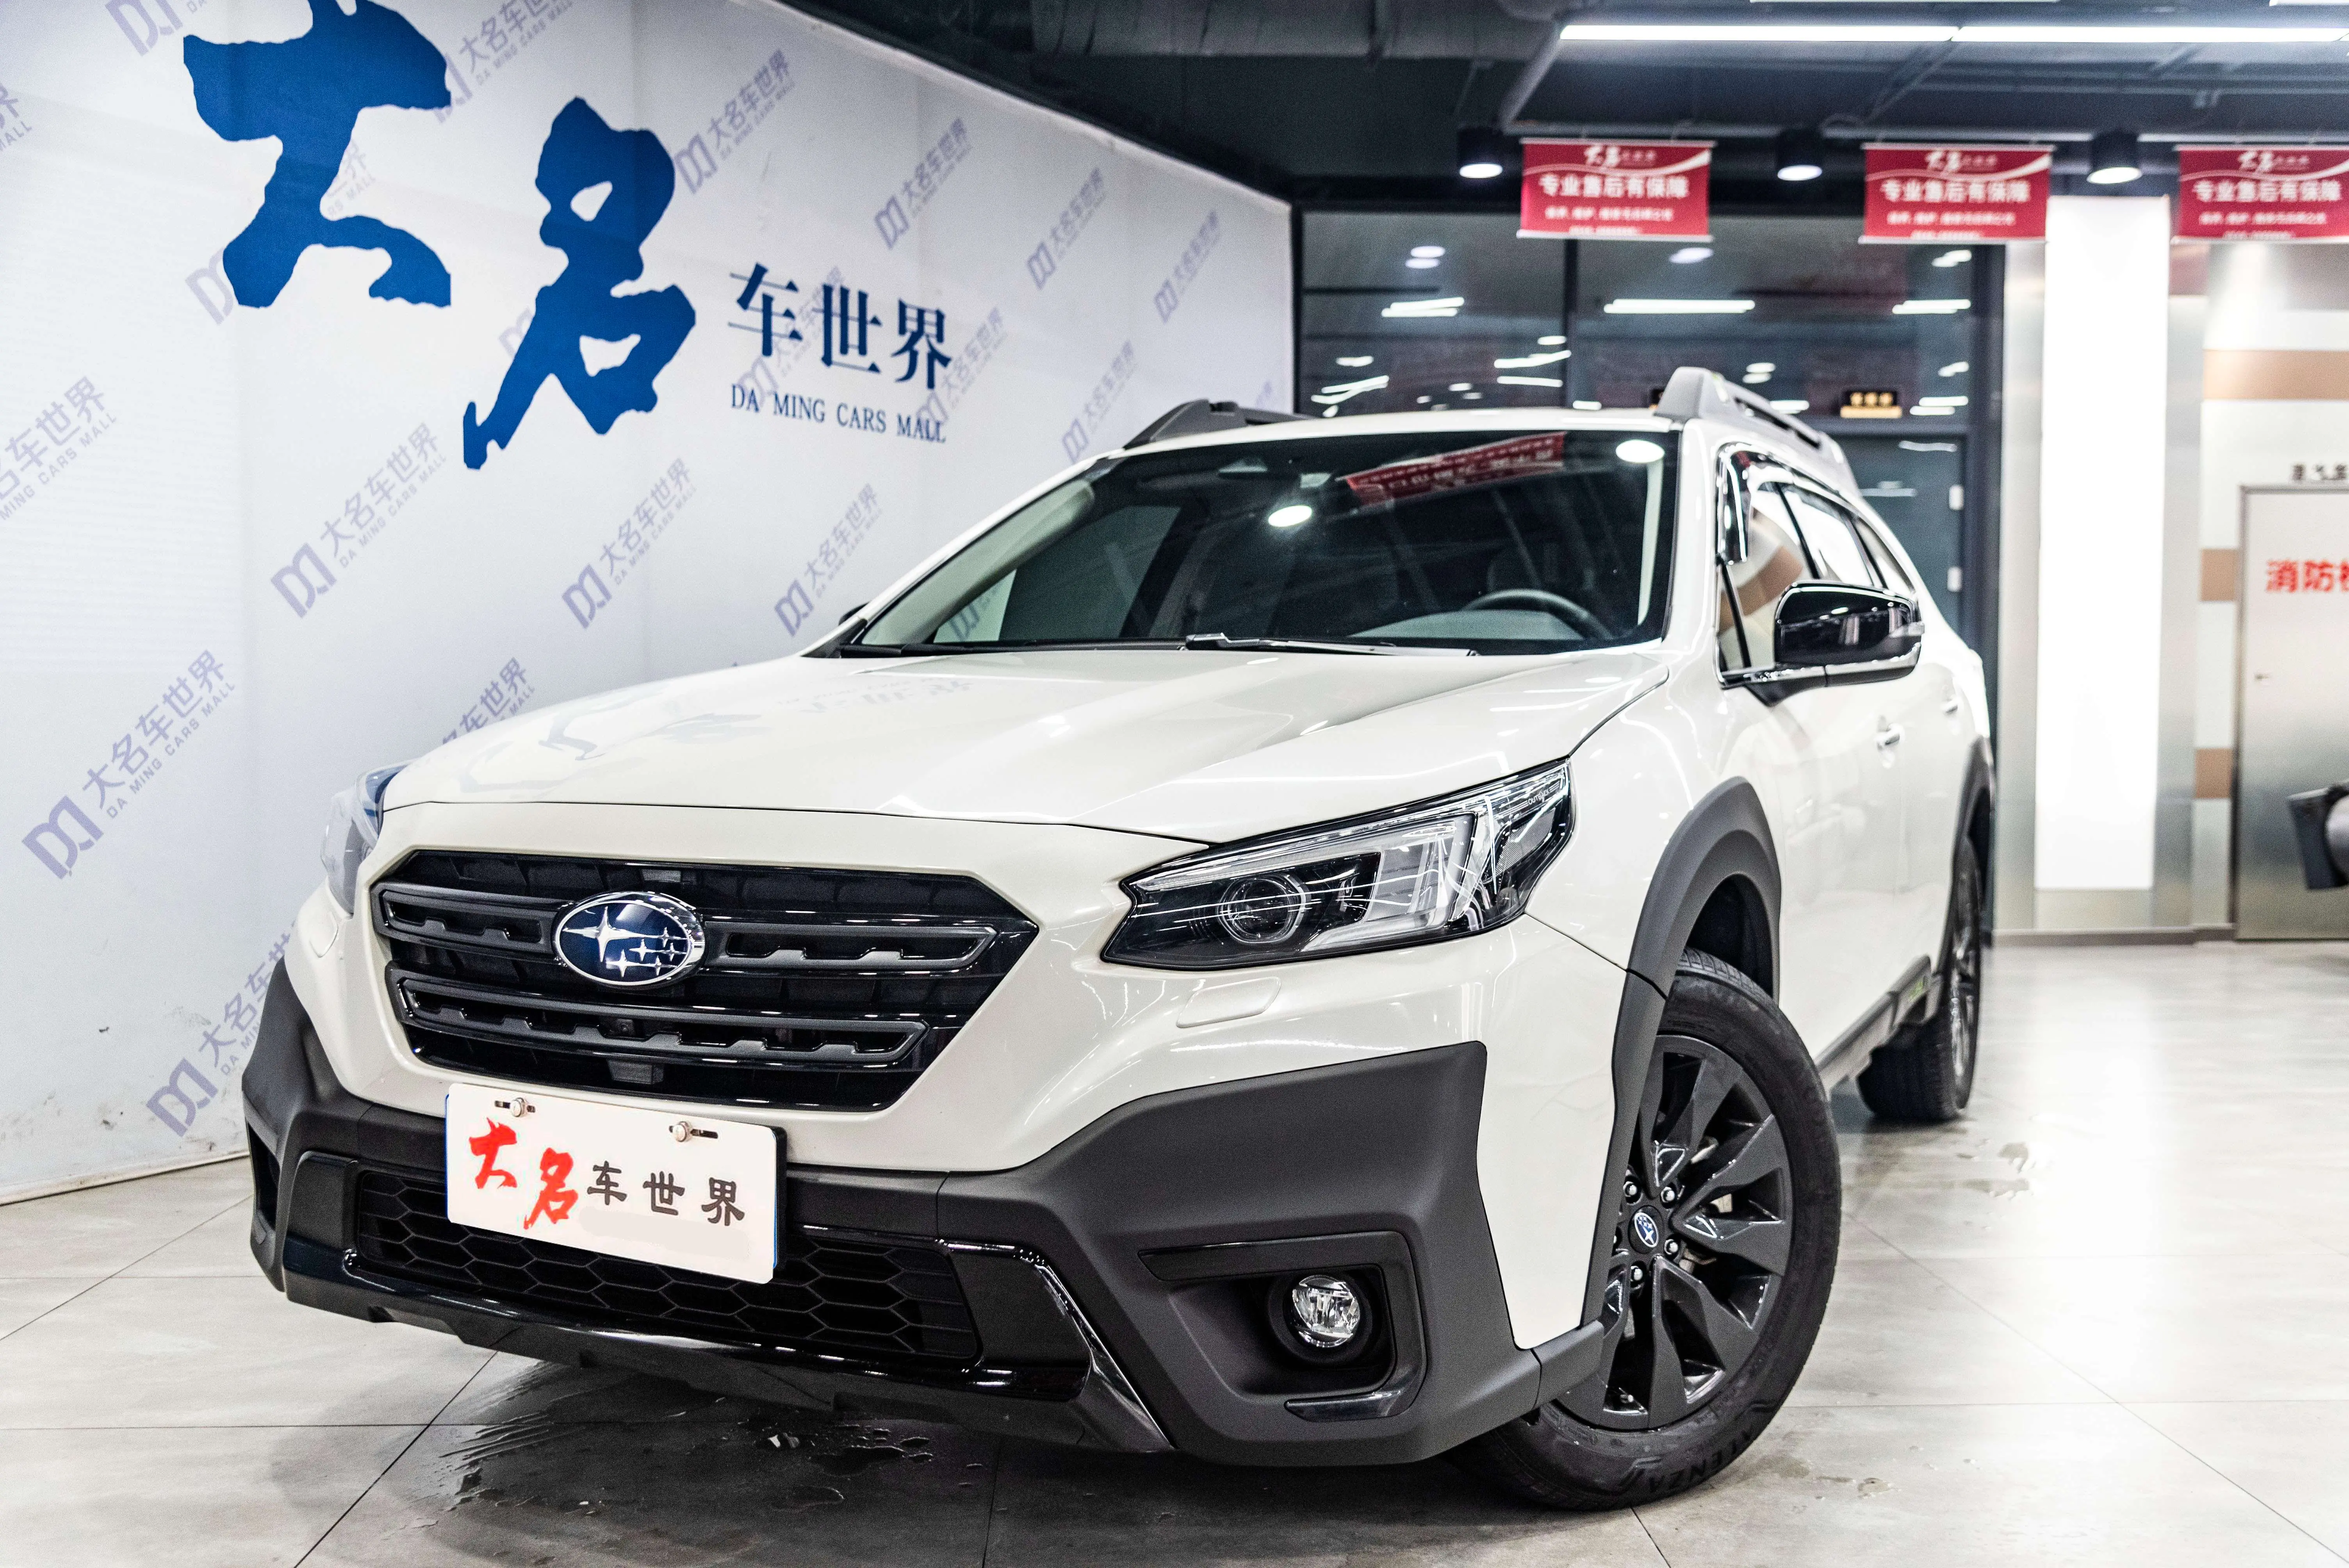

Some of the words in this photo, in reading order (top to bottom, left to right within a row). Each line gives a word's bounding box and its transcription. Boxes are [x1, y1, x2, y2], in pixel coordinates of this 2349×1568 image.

[728, 262, 952, 390] 车世界
[0, 485, 35, 520] MING
[38, 447, 77, 485] CARS
[80, 413, 117, 447] MALL
[732, 384, 759, 412] DA
[773, 390, 825, 423] MING
[837, 402, 886, 433] CARS
[897, 413, 946, 443] MALL
[320, 422, 438, 558] 大名车世界
[340, 549, 357, 568] DA
[358, 516, 386, 547] MING
[388, 484, 417, 517] CARS
[419, 454, 447, 483] MALL
[600, 458, 690, 576] 大名车世界
[804, 483, 877, 590] 大名车世界
[83, 650, 223, 810] 大名车世界
[106, 798, 128, 820] DA
[129, 757, 162, 794] MING
[164, 718, 200, 756] CARS
[201, 682, 235, 717] MALL
[443, 657, 527, 744] 车世界
[1528, 788, 1550, 805] OUTBACK
[241, 1021, 260, 1050] MIN
